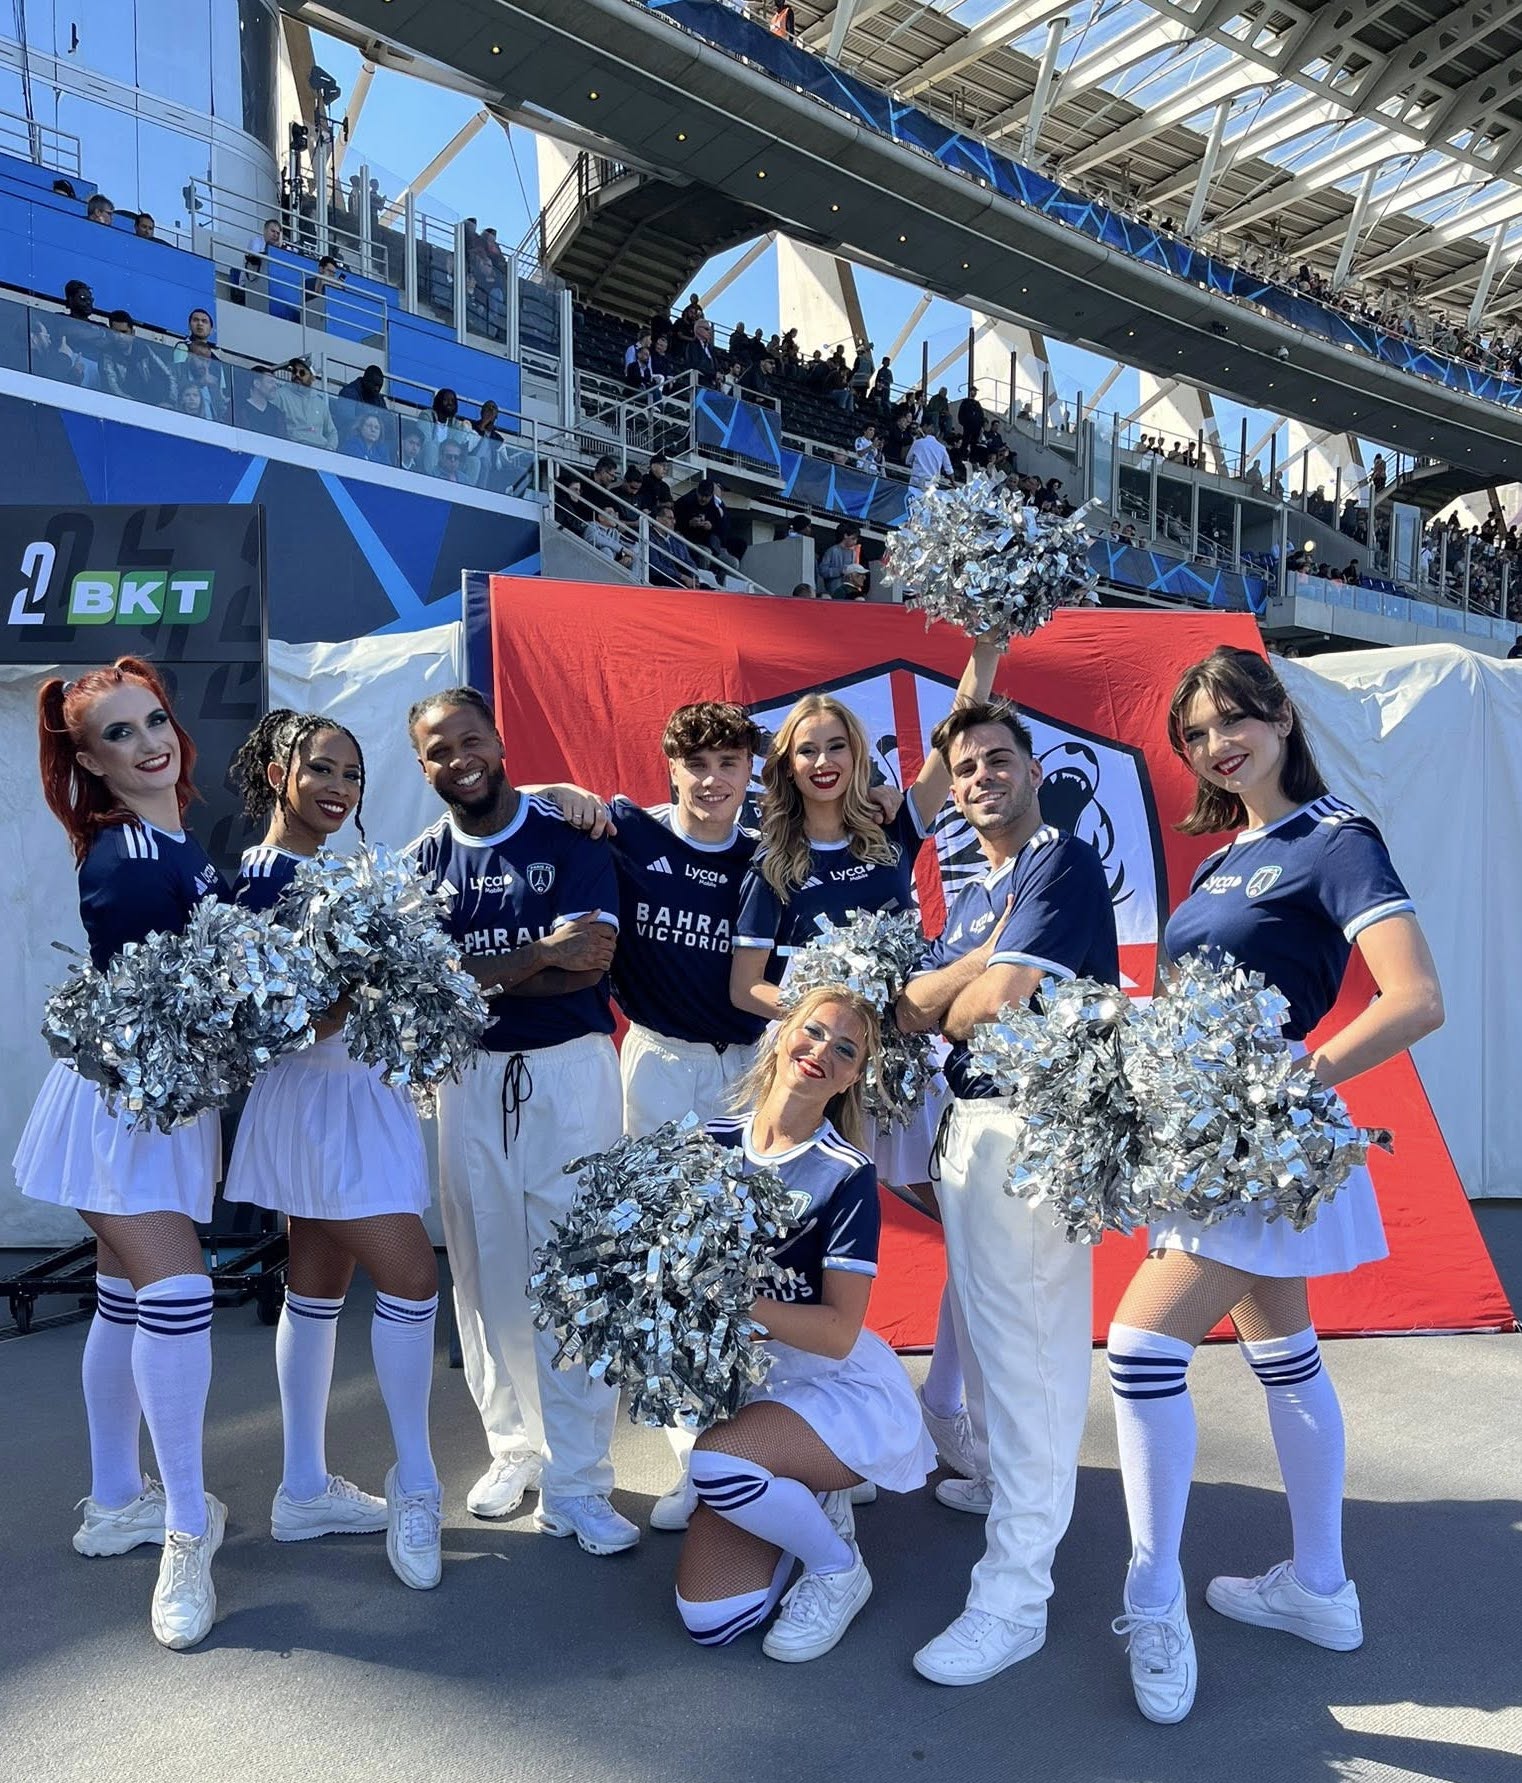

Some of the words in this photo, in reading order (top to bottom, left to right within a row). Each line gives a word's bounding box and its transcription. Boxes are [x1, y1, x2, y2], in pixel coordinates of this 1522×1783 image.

[8, 541, 56, 624] 2
[72, 581, 208, 614] BKT
[470, 876, 503, 890] Lyca
[685, 864, 718, 882] Lyca
[830, 866, 865, 881] Lyca
[637, 902, 730, 938] BAHRA
[637, 922, 735, 953] VICTORIO
